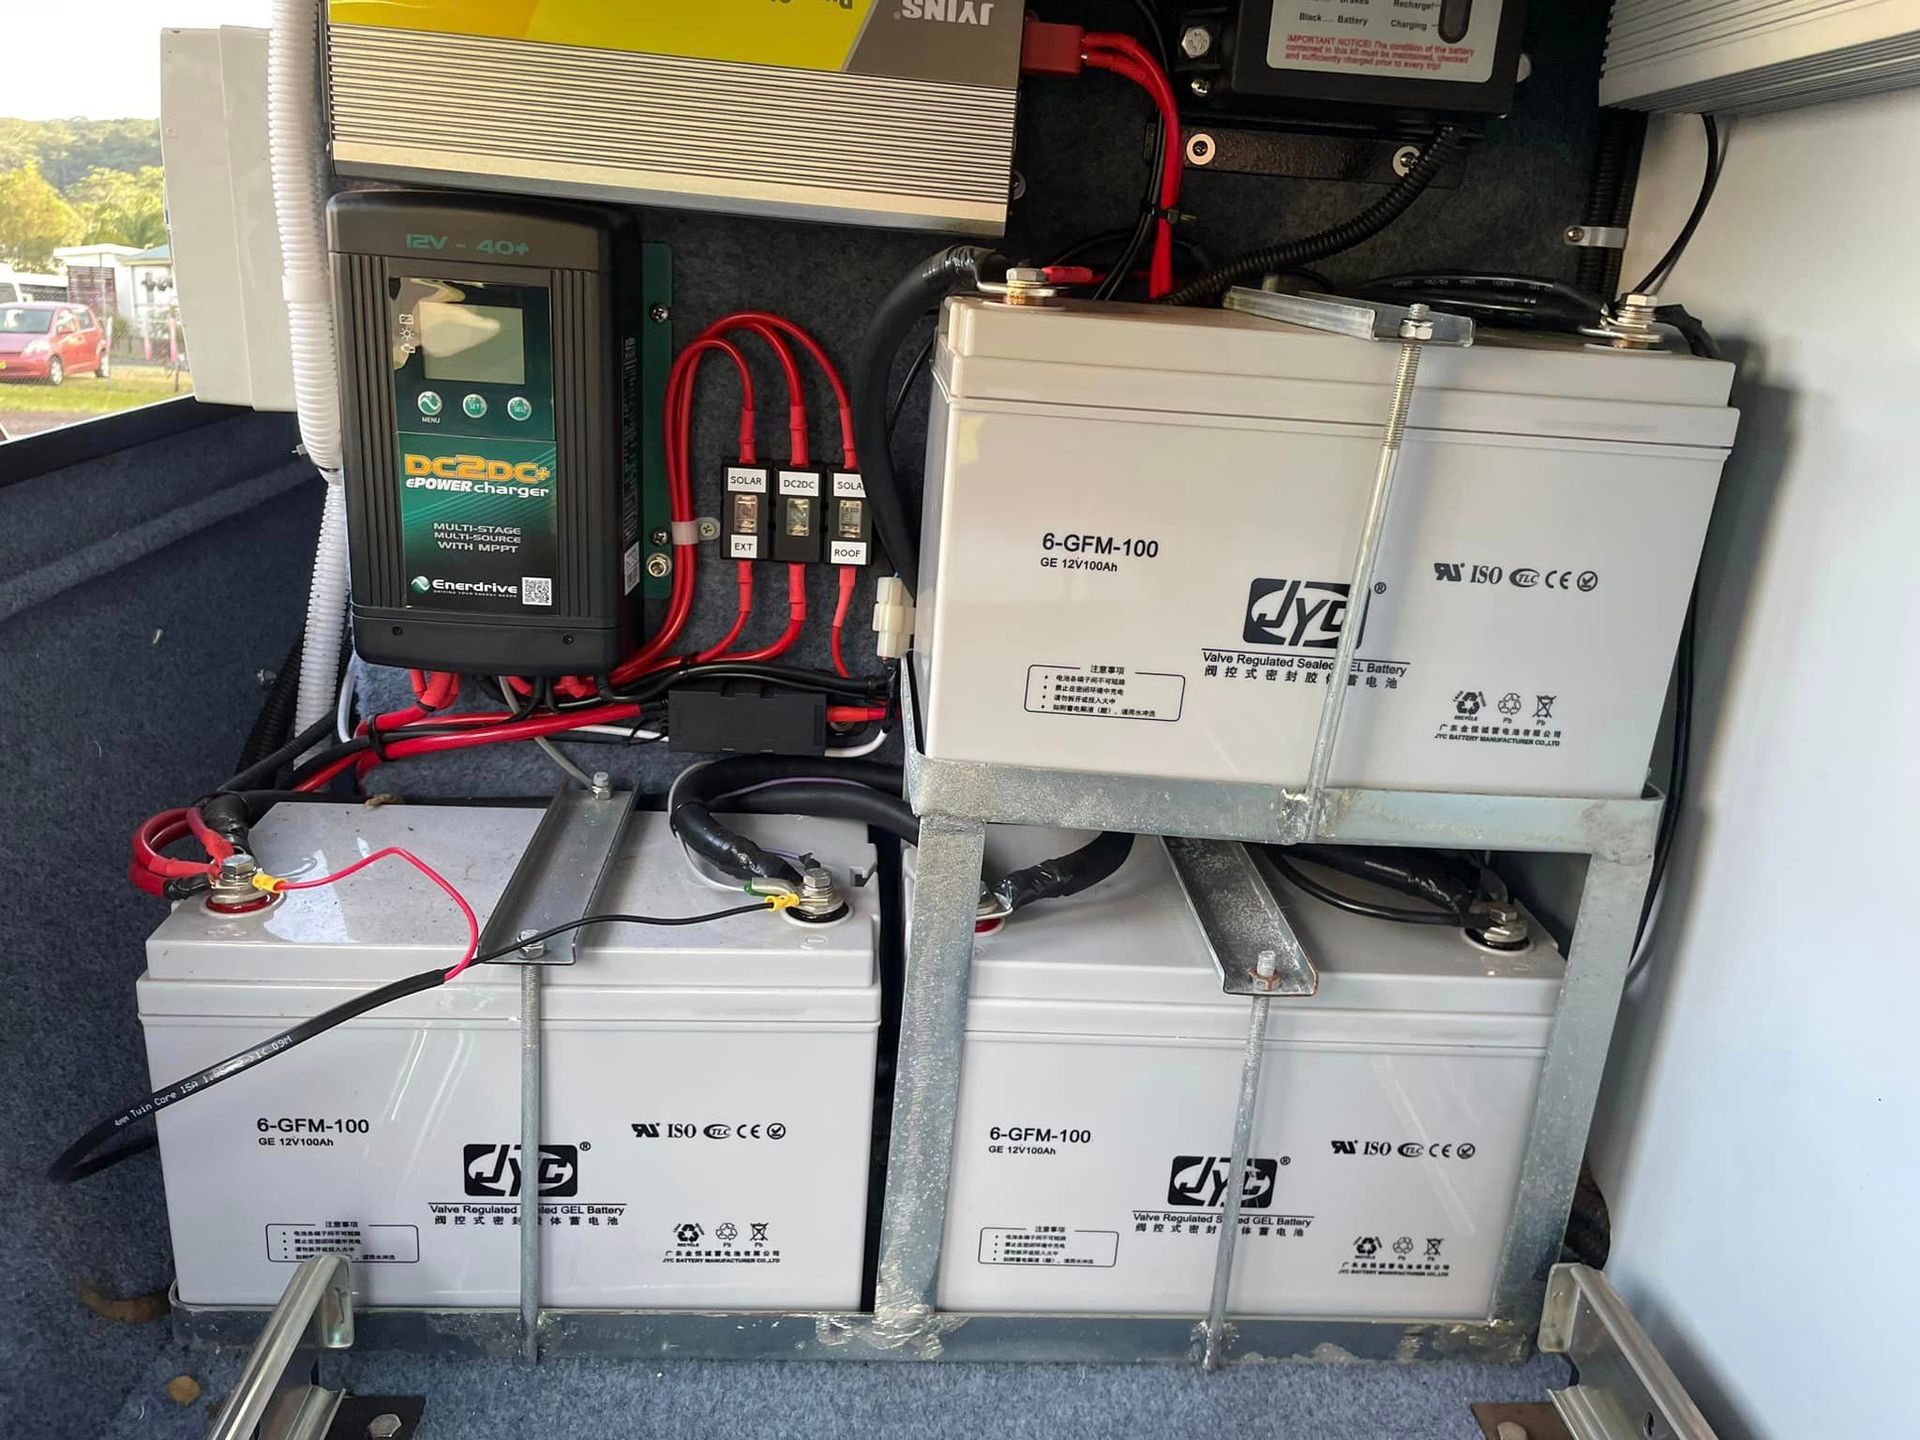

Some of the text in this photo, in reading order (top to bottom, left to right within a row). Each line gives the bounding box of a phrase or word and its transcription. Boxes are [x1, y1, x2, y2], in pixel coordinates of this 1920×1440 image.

[901, 0, 994, 25] JYINS
[1338, 15, 1368, 26] Battery
[1391, 20, 1427, 31] Charging
[1288, 34, 1336, 45] IMPORTANT
[1338, 38, 1371, 46] NOTICE!
[406, 234, 448, 250] 12V
[476, 240, 529, 255] 40+
[404, 453, 550, 484] DC2DC+
[730, 475, 762, 485] SOLAR
[783, 480, 815, 489] DC2DC
[837, 482, 863, 490] SOLA
[406, 478, 549, 498] ePOWER charger
[433, 522, 521, 535] MULTI-STAGE
[434, 532, 521, 543] MULTI-SOURCE
[438, 540, 518, 553] WITH MPPT
[734, 543, 753, 551] EXT
[1042, 532, 1159, 558] 6-GFM-100
[1040, 558, 1118, 572] GE 12V100Ah
[1470, 565, 1502, 584] ISO
[432, 579, 518, 594] Enerdrive
[1203, 652, 1233, 664] Valve
[1237, 654, 1294, 667] Regulated
[1367, 664, 1406, 677] Battery
[1204, 665, 1397, 688] 阀控式密封胶蓄电池
[154, 1092, 177, 1106] Core
[180, 1080, 199, 1094] 15A
[257, 1118, 369, 1133] 6-GFM-100
[667, 1124, 697, 1138] ISO
[258, 1138, 334, 1146] GE 12V100Ah
[990, 1127, 1091, 1143] 6-GFM-100
[988, 1145, 1056, 1155] GE 12V100Ah
[1363, 1142, 1392, 1156] ISO
[430, 1205, 459, 1214] Valve
[463, 1205, 517, 1216] Regulated
[561, 1206, 584, 1214] GEL
[587, 1206, 624, 1216] Battery
[1133, 1213, 1312, 1227] Valve Regulated Sed GEL Battery
